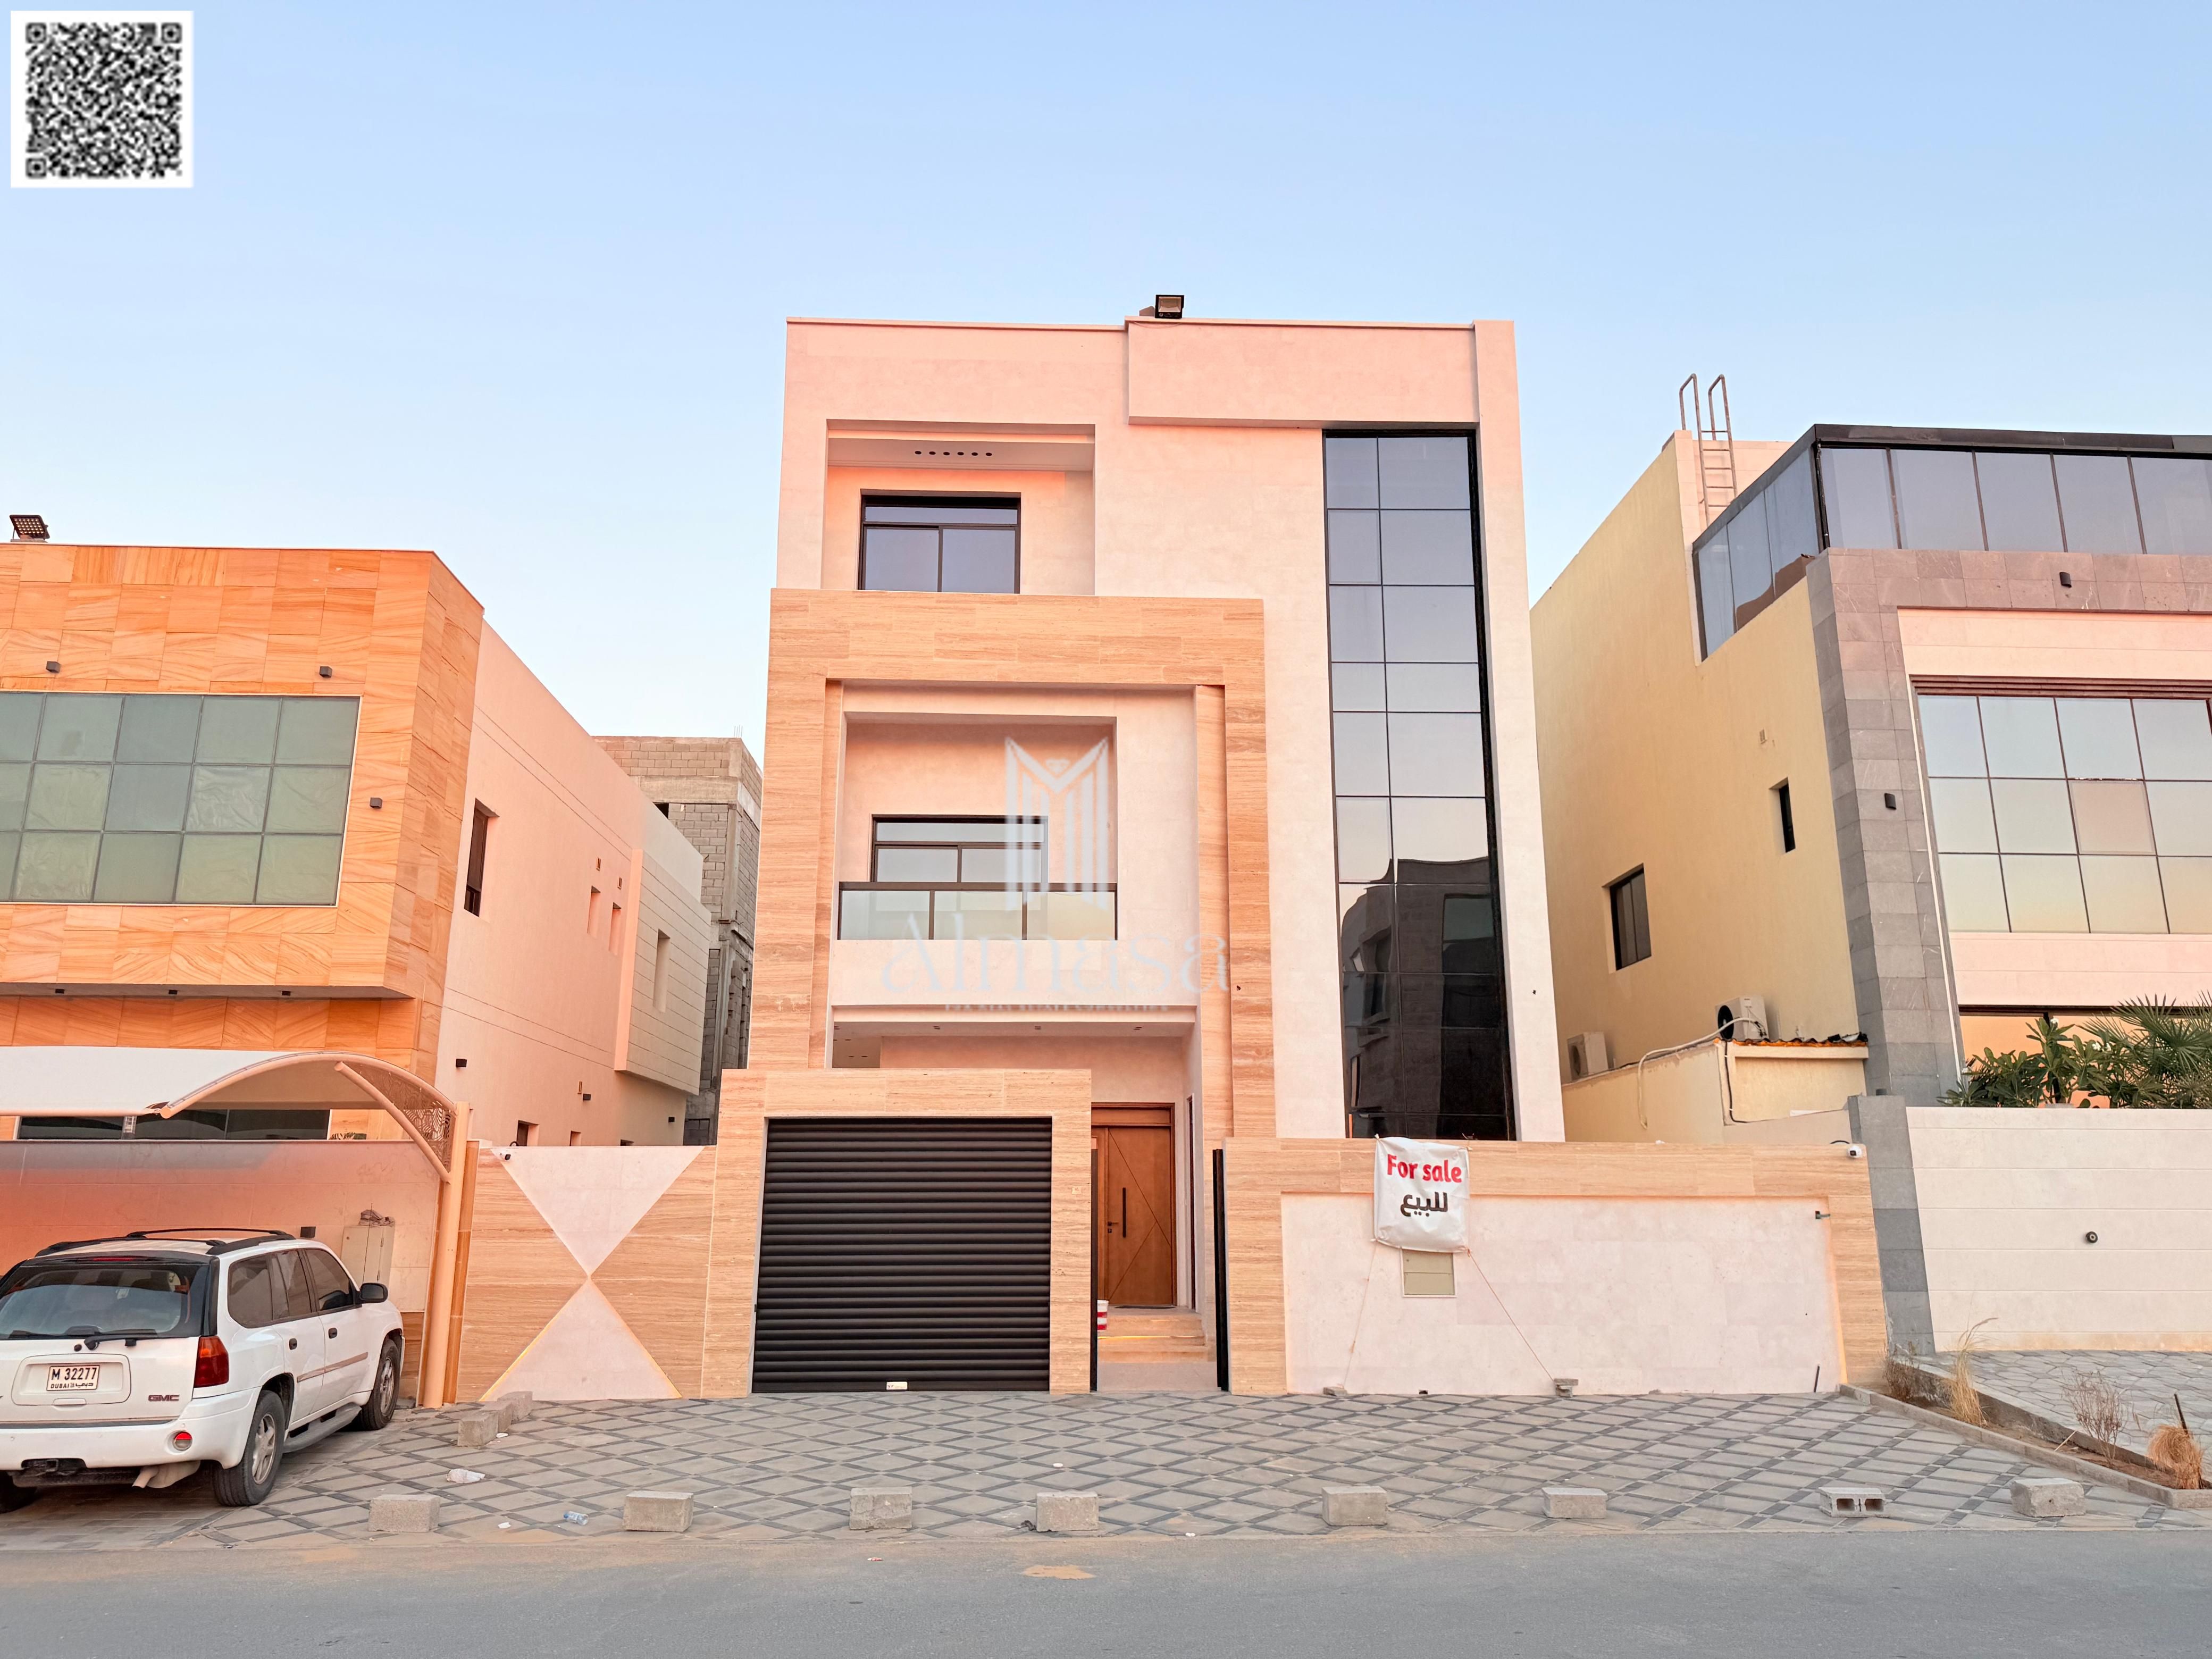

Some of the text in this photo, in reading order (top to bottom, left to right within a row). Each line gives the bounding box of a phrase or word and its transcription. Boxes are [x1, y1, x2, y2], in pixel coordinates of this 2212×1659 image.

[1387, 1154, 1462, 1183] For sale
[1400, 1192, 1448, 1217] للبيع
[51, 1367, 97, 1380] M 32277
